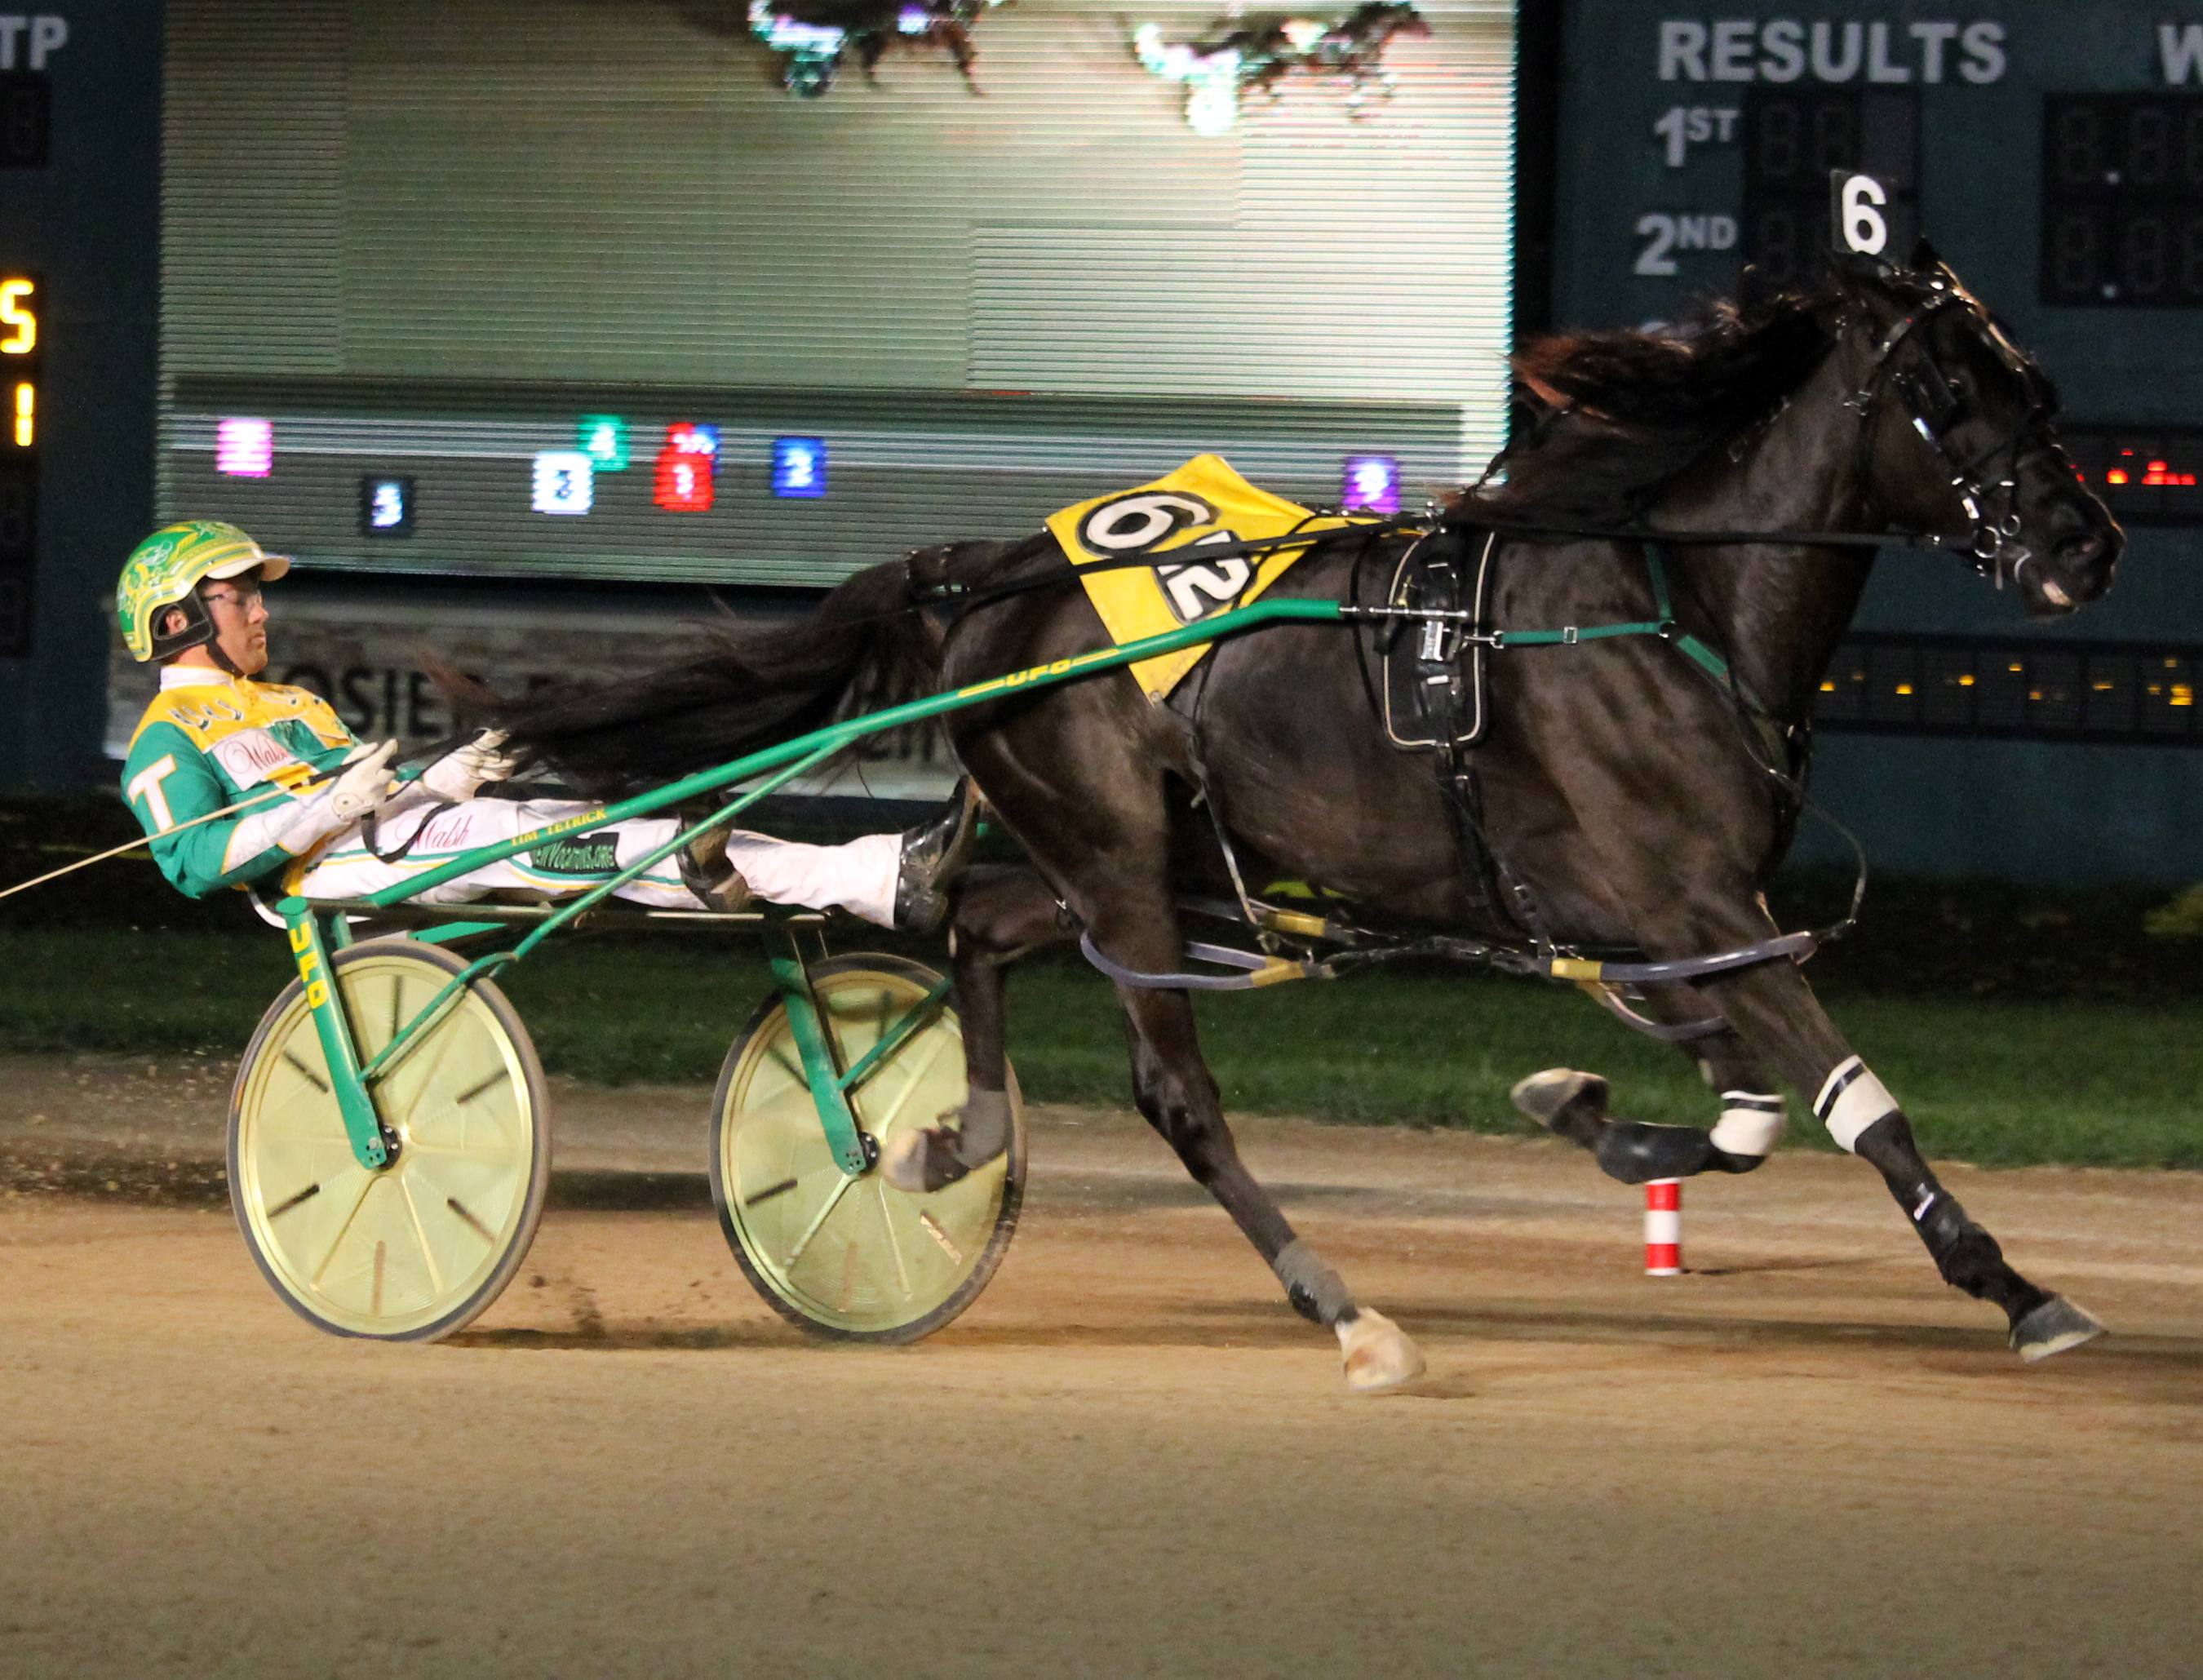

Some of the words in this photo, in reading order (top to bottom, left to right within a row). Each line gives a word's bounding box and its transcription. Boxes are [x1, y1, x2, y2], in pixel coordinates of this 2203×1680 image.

[1659, 20, 2006, 82] RESULTS
[1655, 107, 1739, 166] 1ST
[1635, 214, 1737, 274] 2ND
[1842, 175, 1887, 255] 6
[1085, 493, 1212, 551] 6
[1006, 659, 1071, 687] UFO
[127, 754, 178, 833] T
[511, 831, 539, 847] TIM
[547, 809, 607, 836] TETRICK
[290, 921, 329, 1009] UFO
